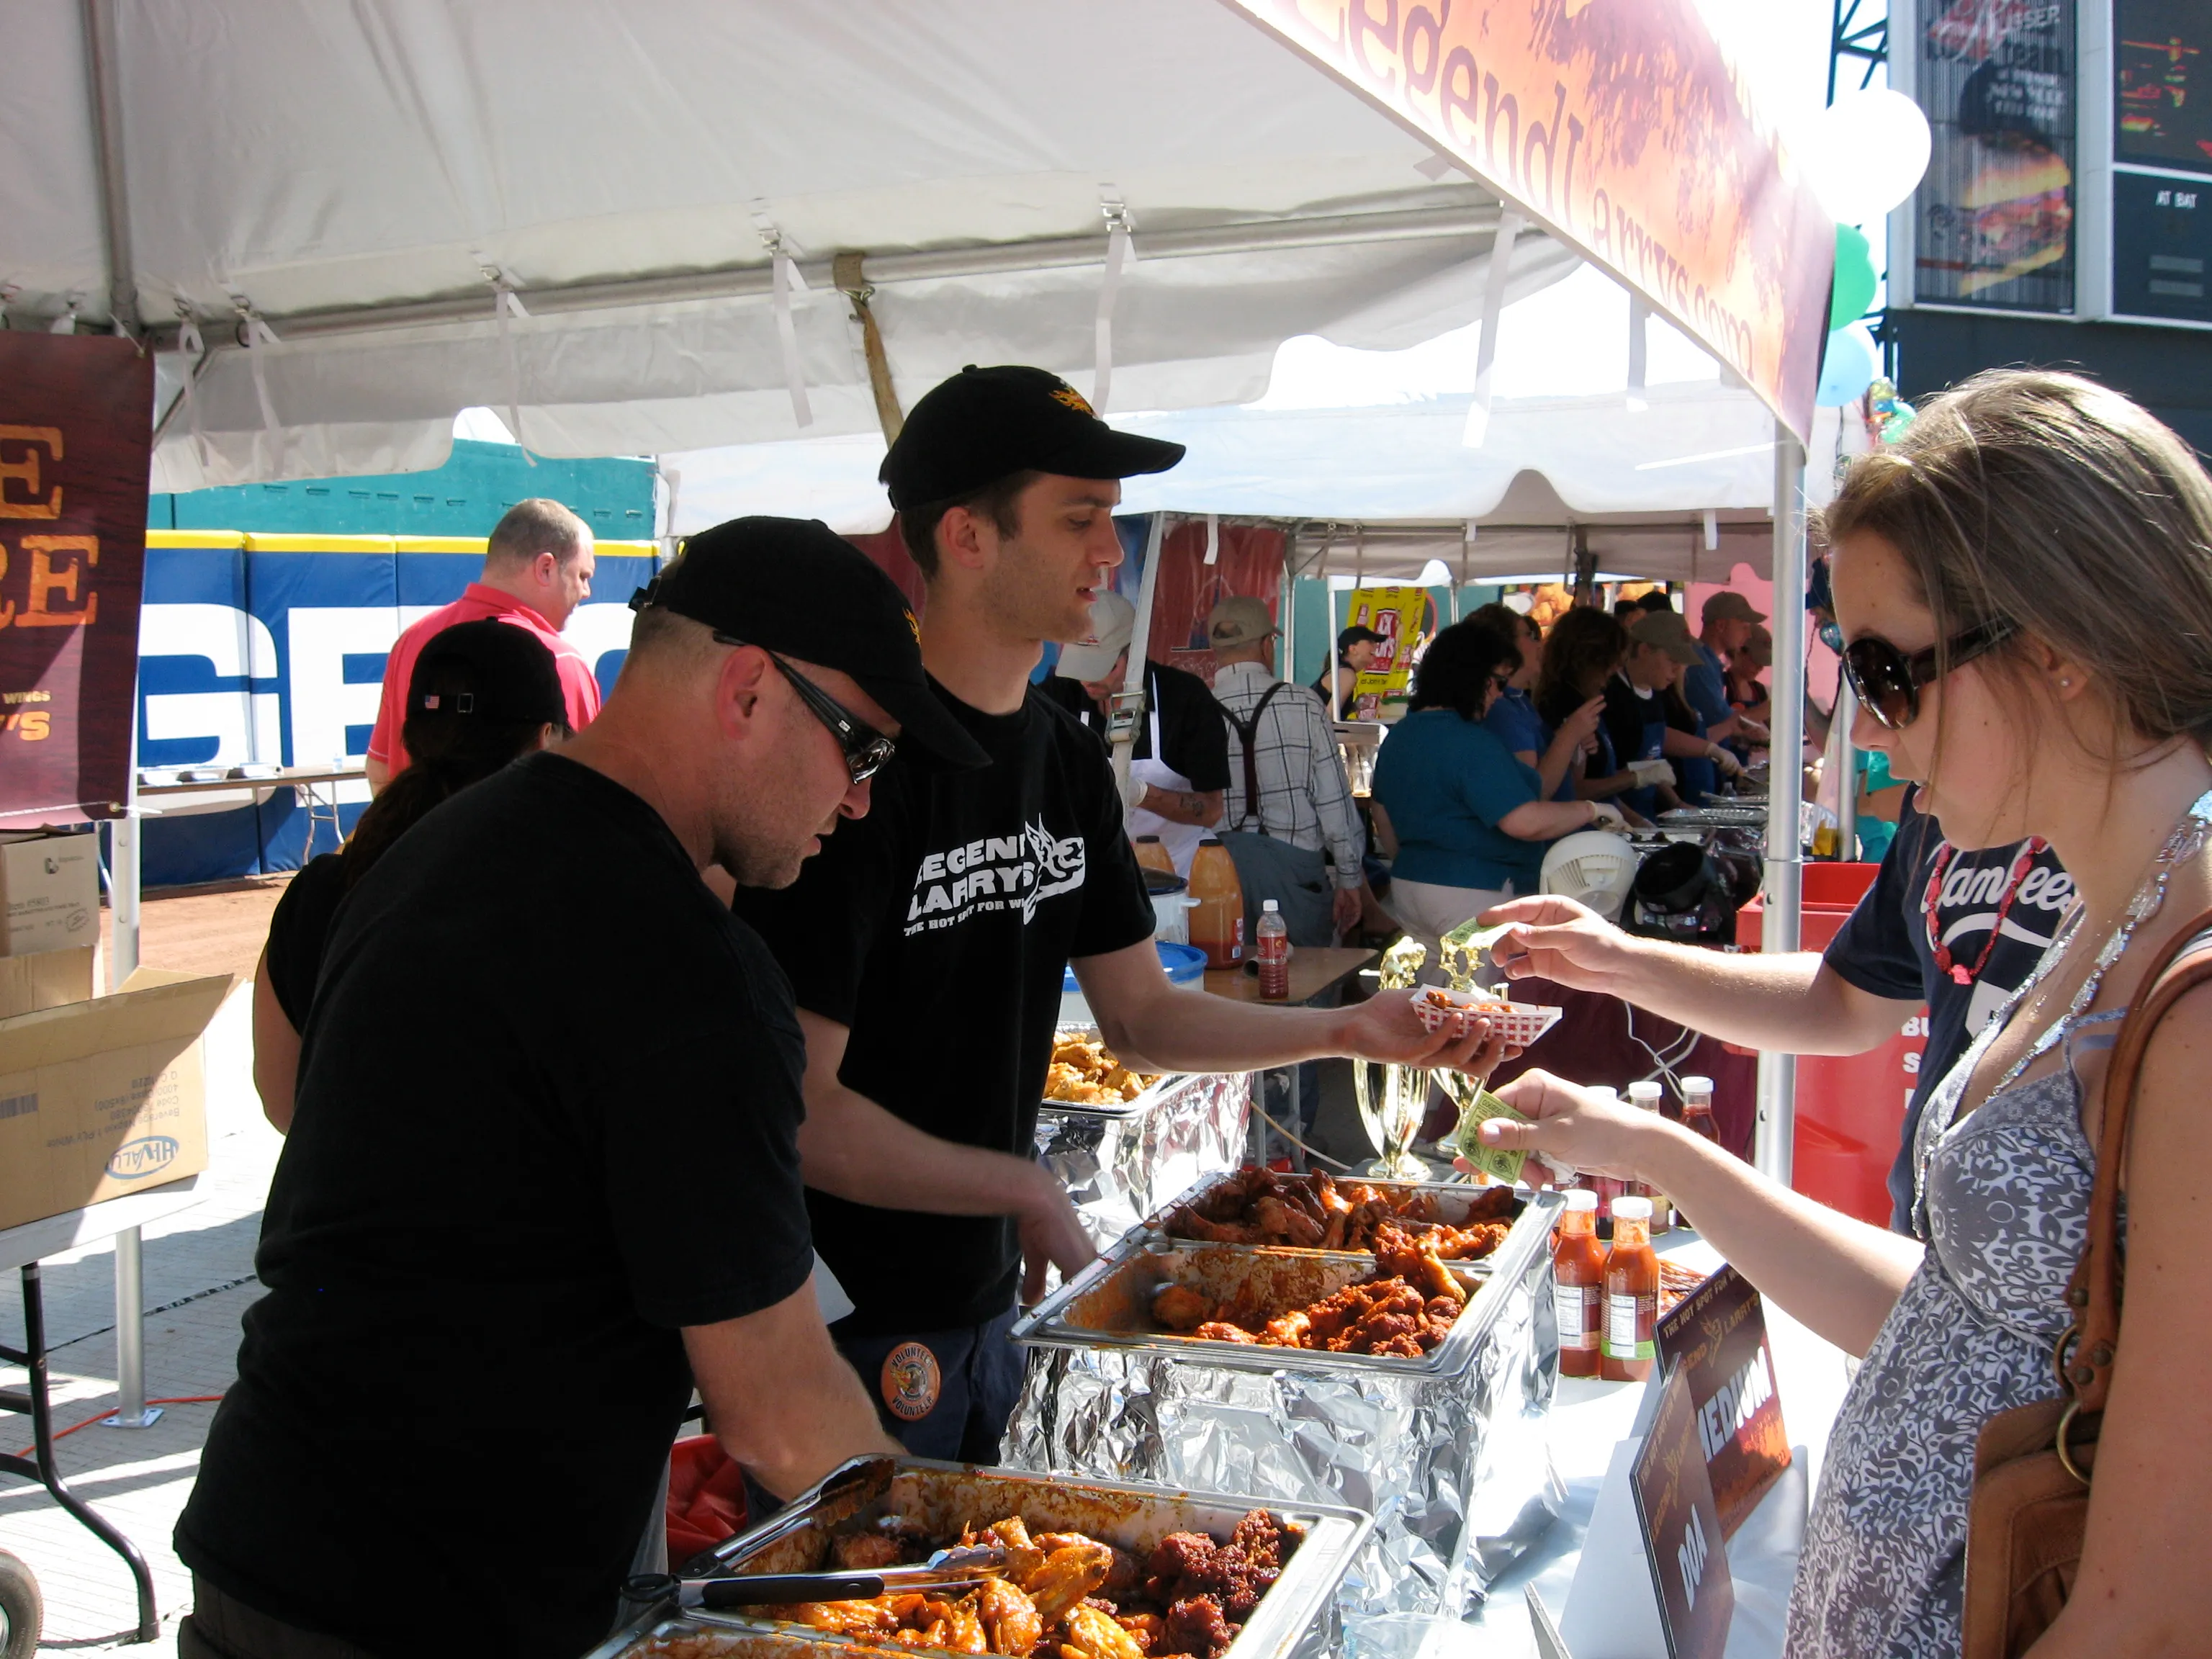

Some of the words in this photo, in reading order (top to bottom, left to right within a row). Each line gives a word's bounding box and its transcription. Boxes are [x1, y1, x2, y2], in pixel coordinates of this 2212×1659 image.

[2155, 191, 2172, 206] AT
[2174, 191, 2198, 209] BAT
[0, 534, 99, 629] E
[904, 921, 925, 936] THE
[929, 916, 955, 930] HOT
[957, 904, 975, 924] SPT
[977, 900, 1004, 912] FOR
[1902, 1017, 1930, 1037] BU
[1663, 1318, 1679, 1339] THE
[1679, 1306, 1695, 1326] HOT
[1696, 1288, 1714, 1310] SPOT
[891, 1346, 934, 1367] VOLUNTEER
[892, 1395, 934, 1416] VOLUNTEER
[1677, 1503, 1708, 1611] DOA
